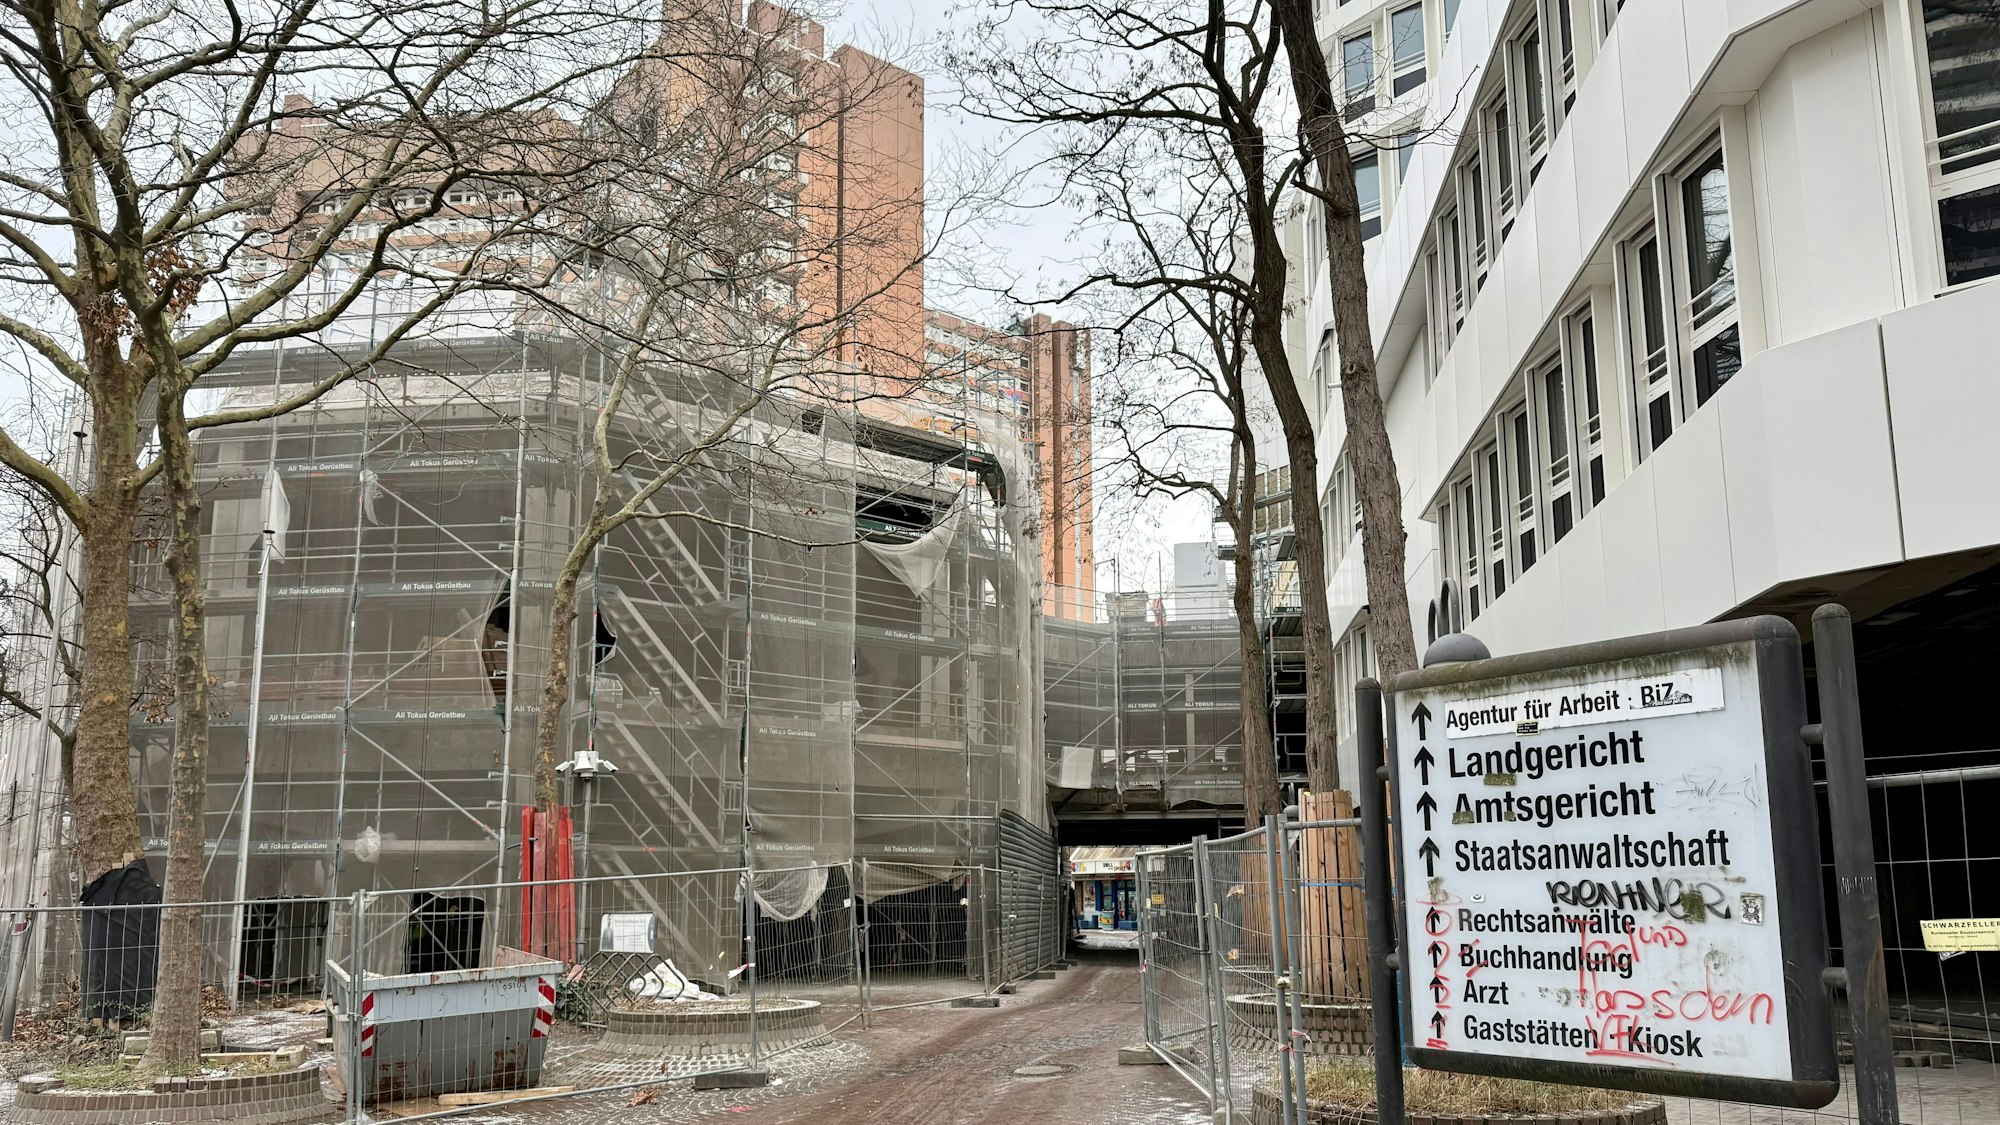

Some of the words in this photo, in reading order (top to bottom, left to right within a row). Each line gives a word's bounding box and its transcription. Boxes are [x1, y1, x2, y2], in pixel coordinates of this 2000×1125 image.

[435, 582, 471, 590] Gerüstbau
[269, 713, 279, 721] Ali
[395, 711, 405, 719] Ali
[407, 711, 427, 719] Tokus
[429, 711, 465, 719] Gerüstbau
[1446, 705, 1517, 731] Agentur
[1524, 699, 1552, 720] für
[1559, 690, 1620, 716] Arbeit
[1641, 682, 1674, 707] BiZ
[1449, 730, 1645, 780] Landgericht
[1454, 781, 1656, 828] Amtsgericht
[1455, 829, 1730, 872] Staatsanwaltschaft
[1458, 908, 1636, 934] Rechtsanwälte
[1460, 943, 1633, 979] Buchhandlung
[1463, 979, 1509, 1005] Arzt
[1463, 1014, 1598, 1049] Gaststätten
[1628, 1025, 1703, 1057] Kiosk
